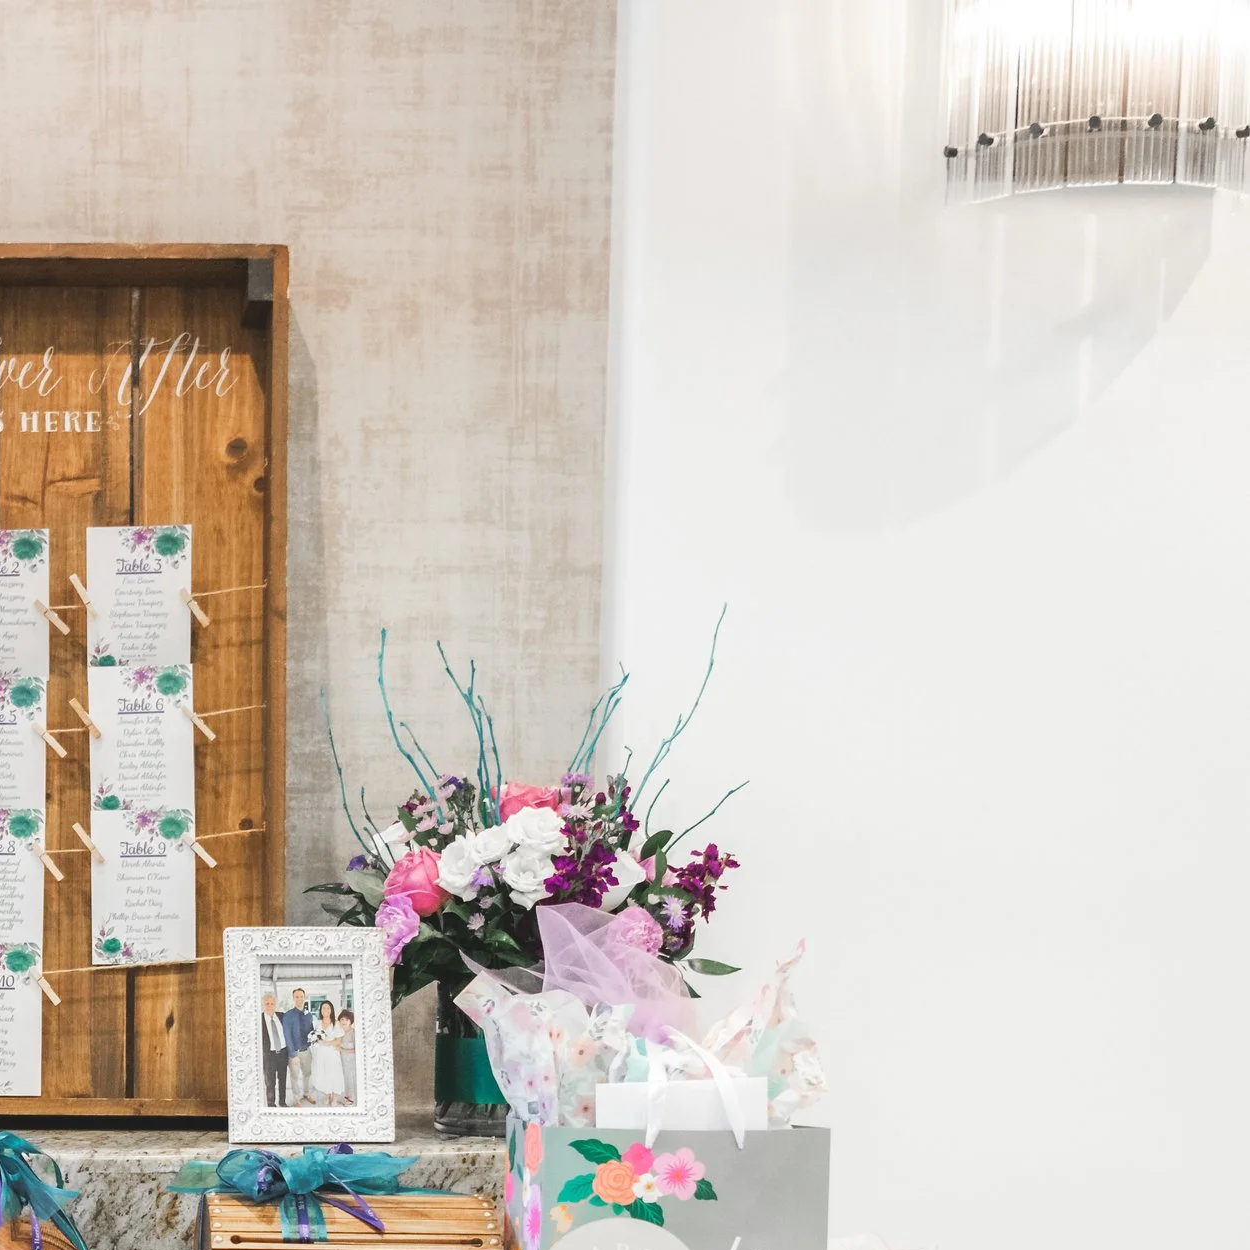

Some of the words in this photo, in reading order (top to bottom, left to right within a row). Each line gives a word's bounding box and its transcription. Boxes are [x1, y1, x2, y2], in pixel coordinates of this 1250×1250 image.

[86, 331, 240, 417] After
[18, 408, 104, 435] HERE
[11, 562, 20, 573] 2
[117, 559, 150, 572] Table
[154, 559, 162, 571] 3
[118, 698, 152, 711] Table
[156, 698, 163, 711] 6
[10, 710, 17, 722] 5
[7, 840, 15, 853] 8
[120, 841, 155, 855] Table
[158, 842, 166, 854] 9
[0, 975, 15, 987] 10
